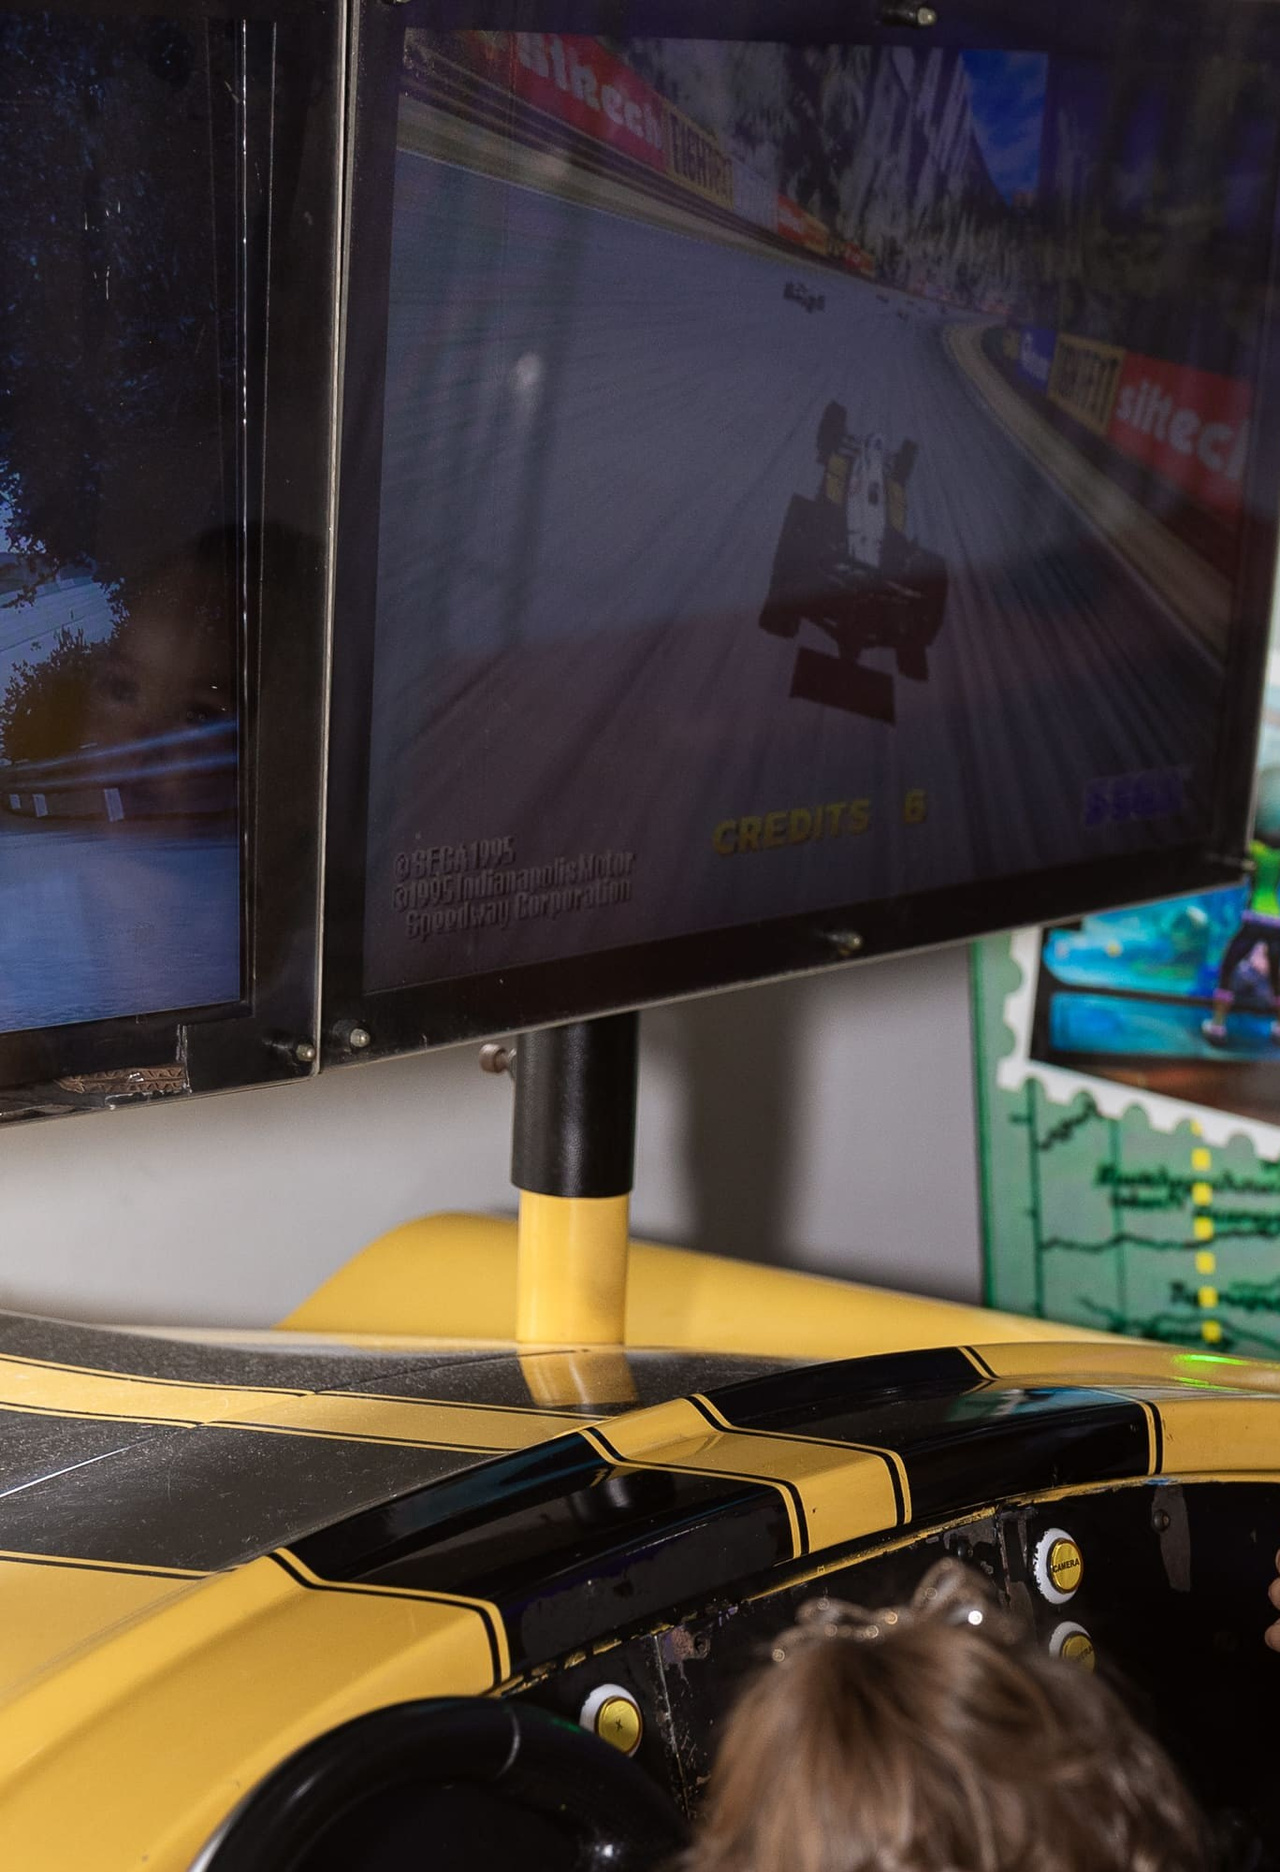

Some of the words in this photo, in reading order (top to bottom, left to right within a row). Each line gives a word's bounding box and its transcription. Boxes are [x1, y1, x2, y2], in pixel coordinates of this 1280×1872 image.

[711, 799, 870, 857] CREDITS
[903, 788, 927, 824] 6
[458, 857, 576, 904] Indianapolis
[580, 850, 636, 883] Motor
[471, 834, 517, 869] 1995
[405, 899, 511, 943] Speedway
[514, 877, 632, 921] Corporation
[1052, 1558, 1080, 1573] CAMERA
